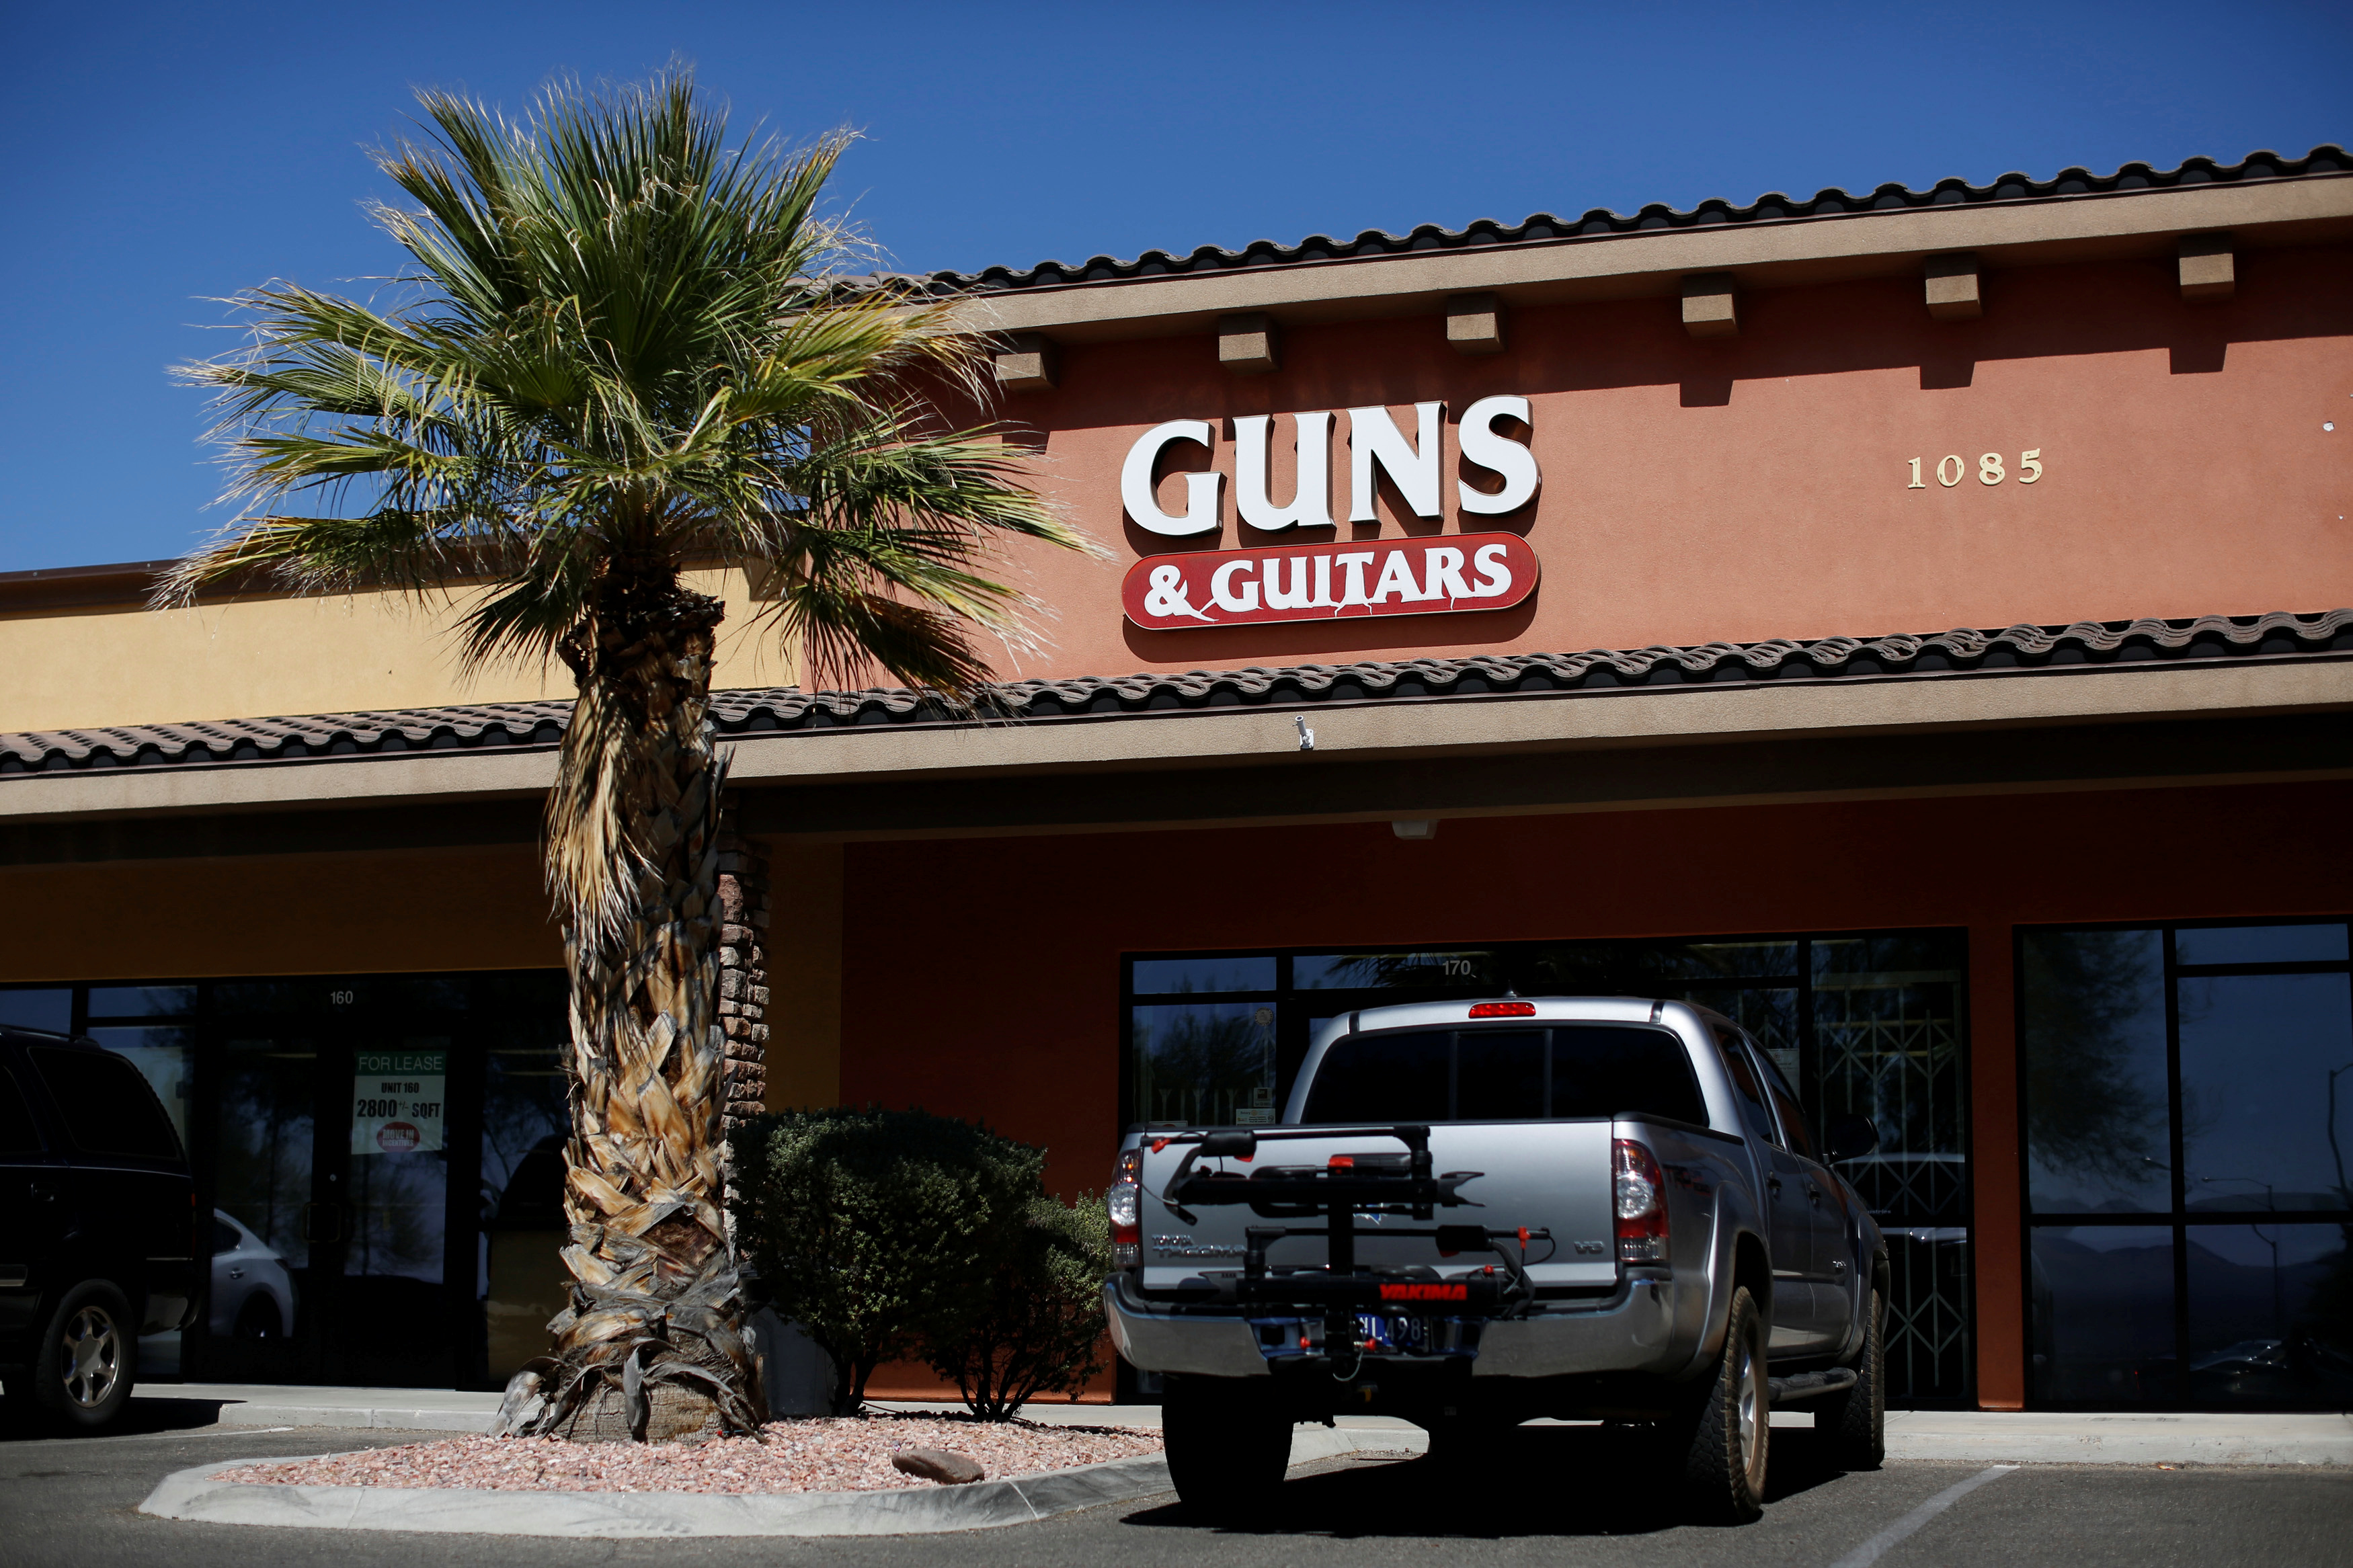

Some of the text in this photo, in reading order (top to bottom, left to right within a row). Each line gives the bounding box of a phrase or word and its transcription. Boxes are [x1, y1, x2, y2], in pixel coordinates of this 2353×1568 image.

[1121, 395, 1540, 536] GUNS
[1908, 448, 2043, 489] 1085
[1144, 544, 1512, 622] & GUITARS
[1442, 960, 1471, 975] 170
[329, 990, 354, 1005] 160
[358, 1057, 442, 1070] FOR LEASE
[381, 1082, 420, 1093] UNIT 160
[412, 1103, 440, 1118] SQFT
[383, 1129, 414, 1139] MOVE IN
[1380, 1283, 1468, 1301] YAKIMA
